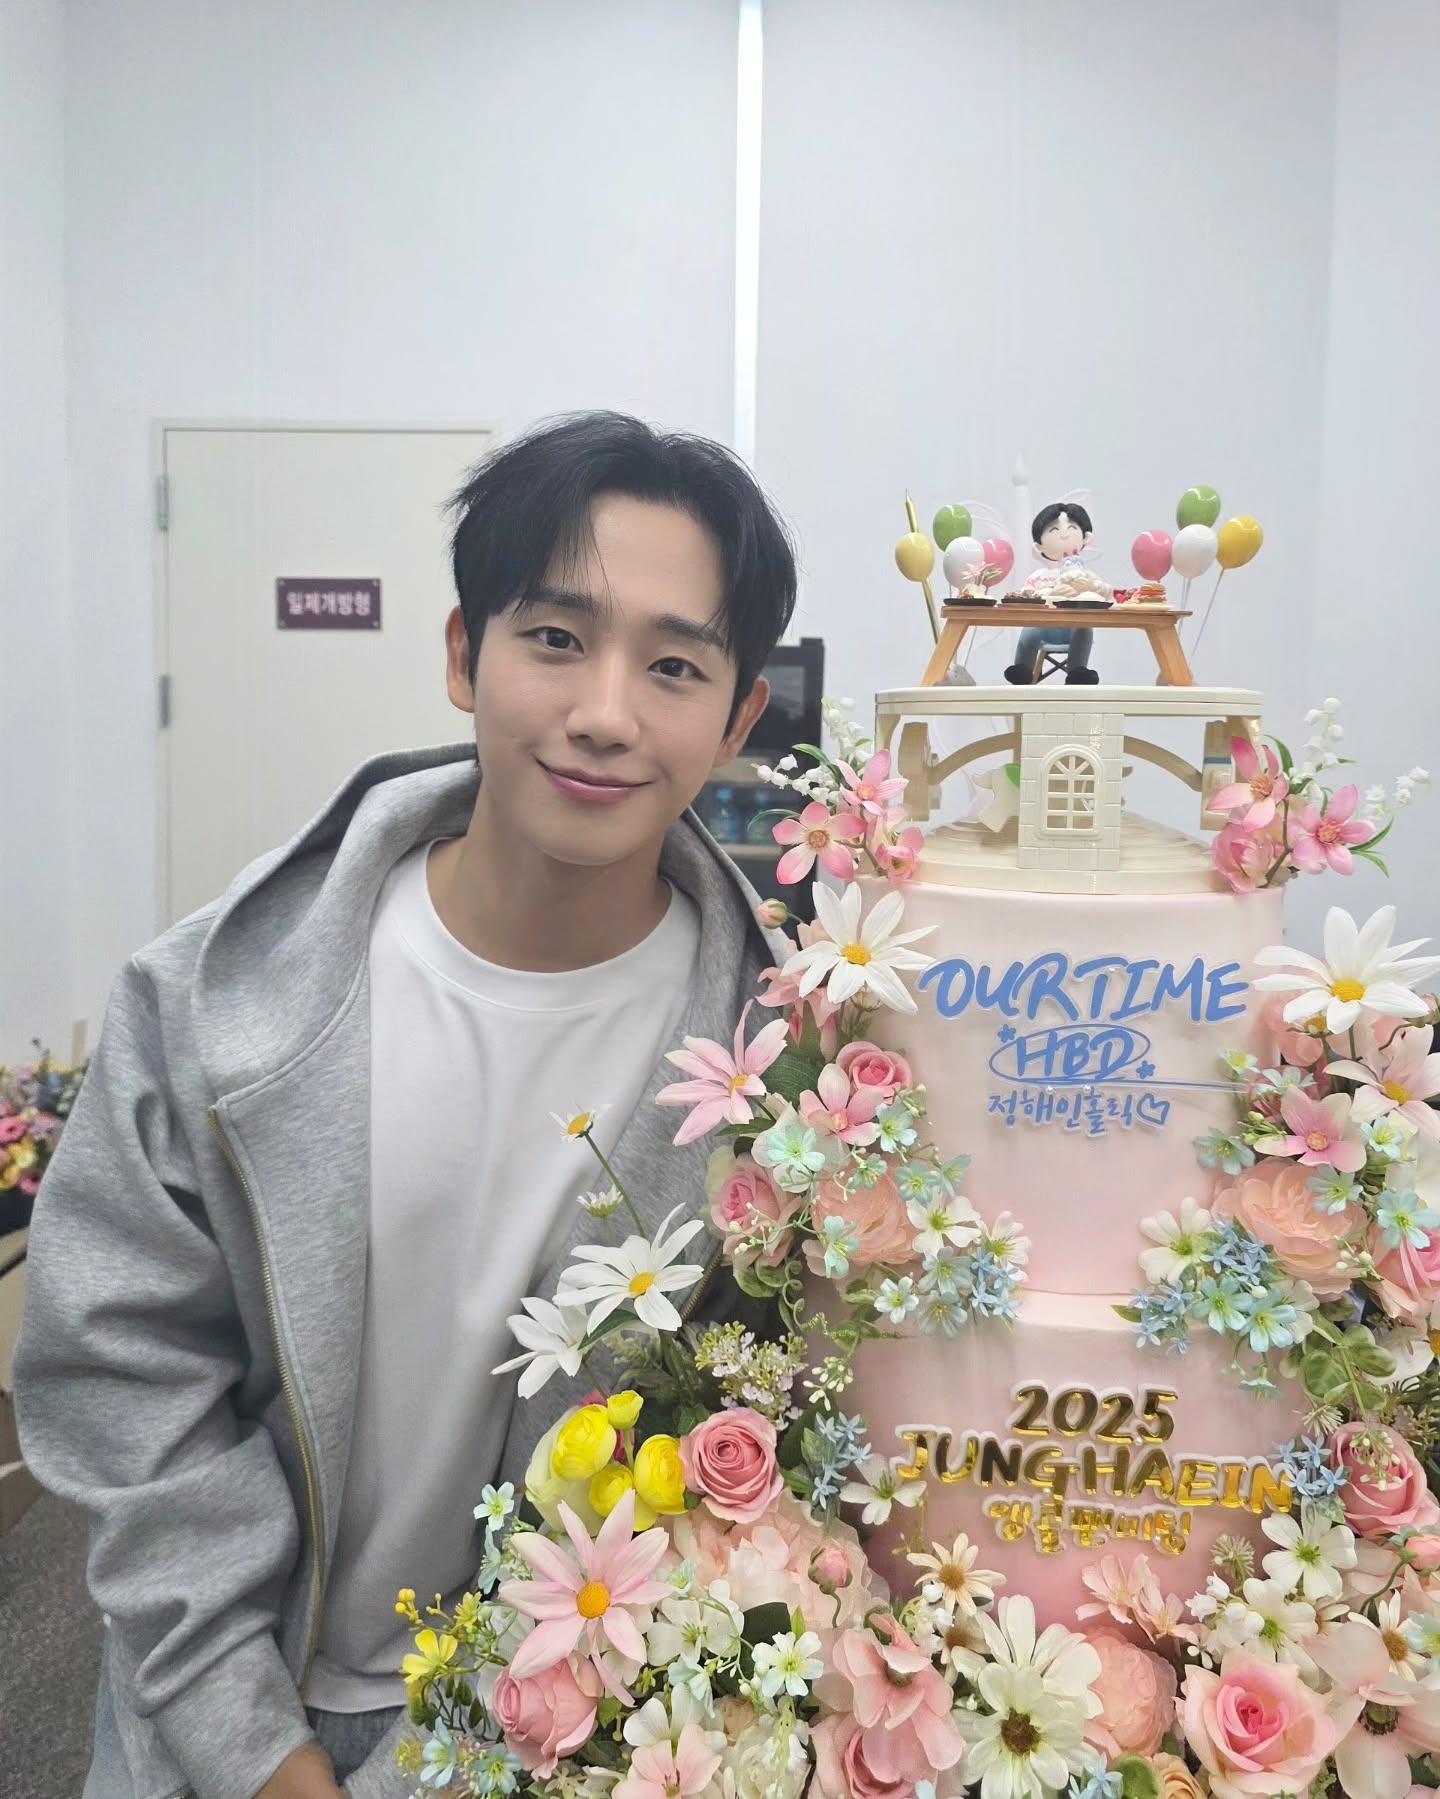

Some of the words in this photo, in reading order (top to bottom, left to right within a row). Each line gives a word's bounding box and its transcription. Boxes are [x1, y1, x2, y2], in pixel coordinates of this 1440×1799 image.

[1016, 1028, 1135, 1081] HBD
[988, 1089, 1134, 1136] 정해인홀릭
[1011, 1387, 1179, 1444] 2025
[895, 1430, 1293, 1514] JUNGHAEIN
